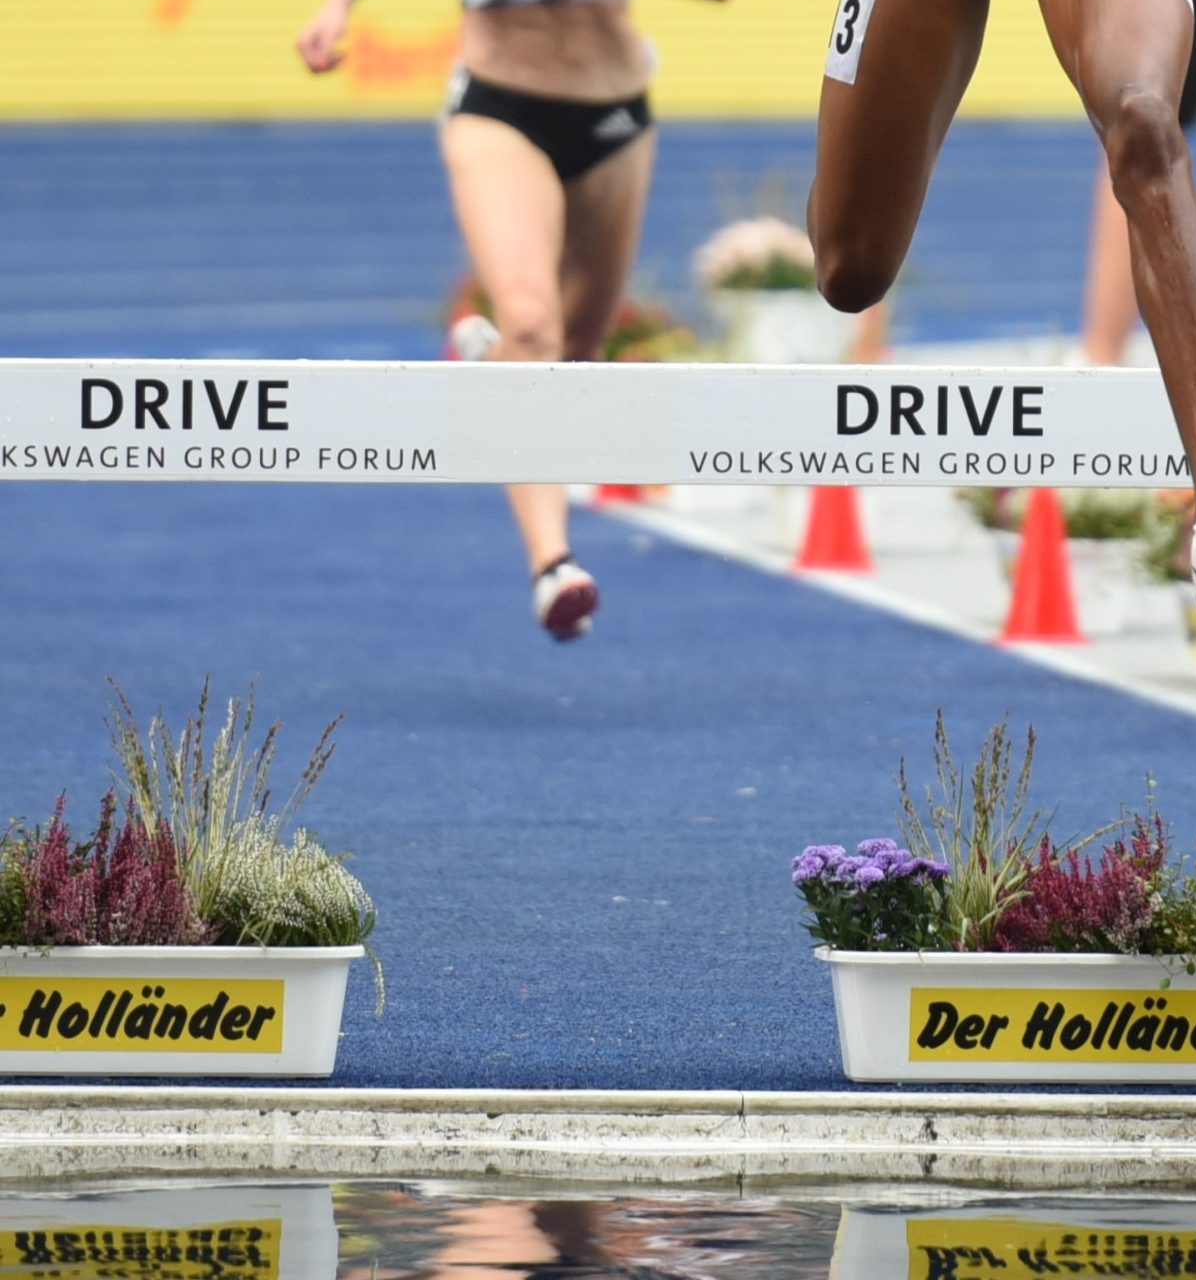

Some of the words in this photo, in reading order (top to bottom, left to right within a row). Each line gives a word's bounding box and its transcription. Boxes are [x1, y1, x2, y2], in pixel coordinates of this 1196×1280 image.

[81, 378, 290, 430] DRIVE
[836, 384, 1045, 436] DRIVE
[1, 445, 166, 469] KSWAGEN
[184, 446, 301, 470] GROUP
[319, 448, 437, 471] FORUM
[690, 451, 921, 474] VOLKSWAGEN
[939, 452, 1055, 475] GROUP
[1073, 453, 1192, 477] FORUM
[19, 985, 275, 1041] Holländer
[917, 1001, 1009, 1050] Der
